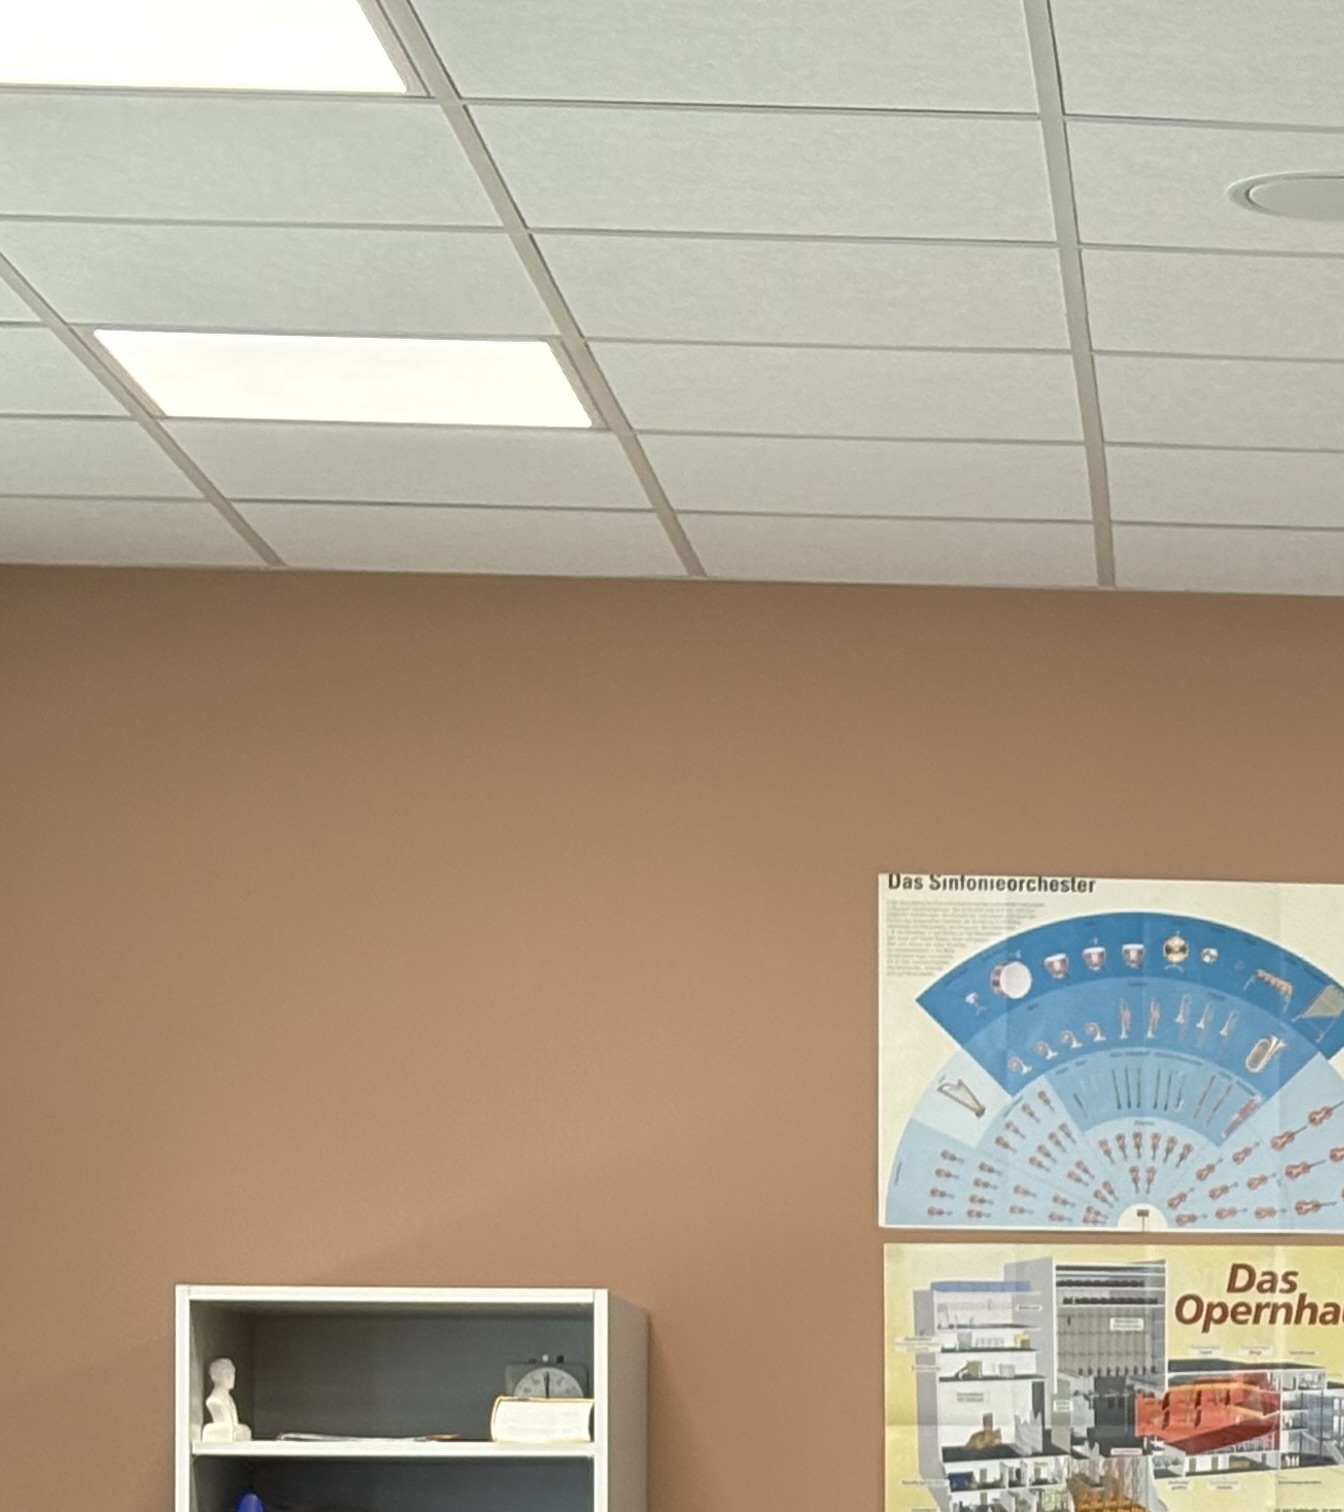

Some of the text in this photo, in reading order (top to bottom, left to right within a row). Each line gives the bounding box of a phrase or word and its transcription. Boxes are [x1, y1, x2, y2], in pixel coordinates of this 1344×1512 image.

[888, 874, 1096, 893] Das Sinfonieorchester
[1226, 1263, 1299, 1294] Das
